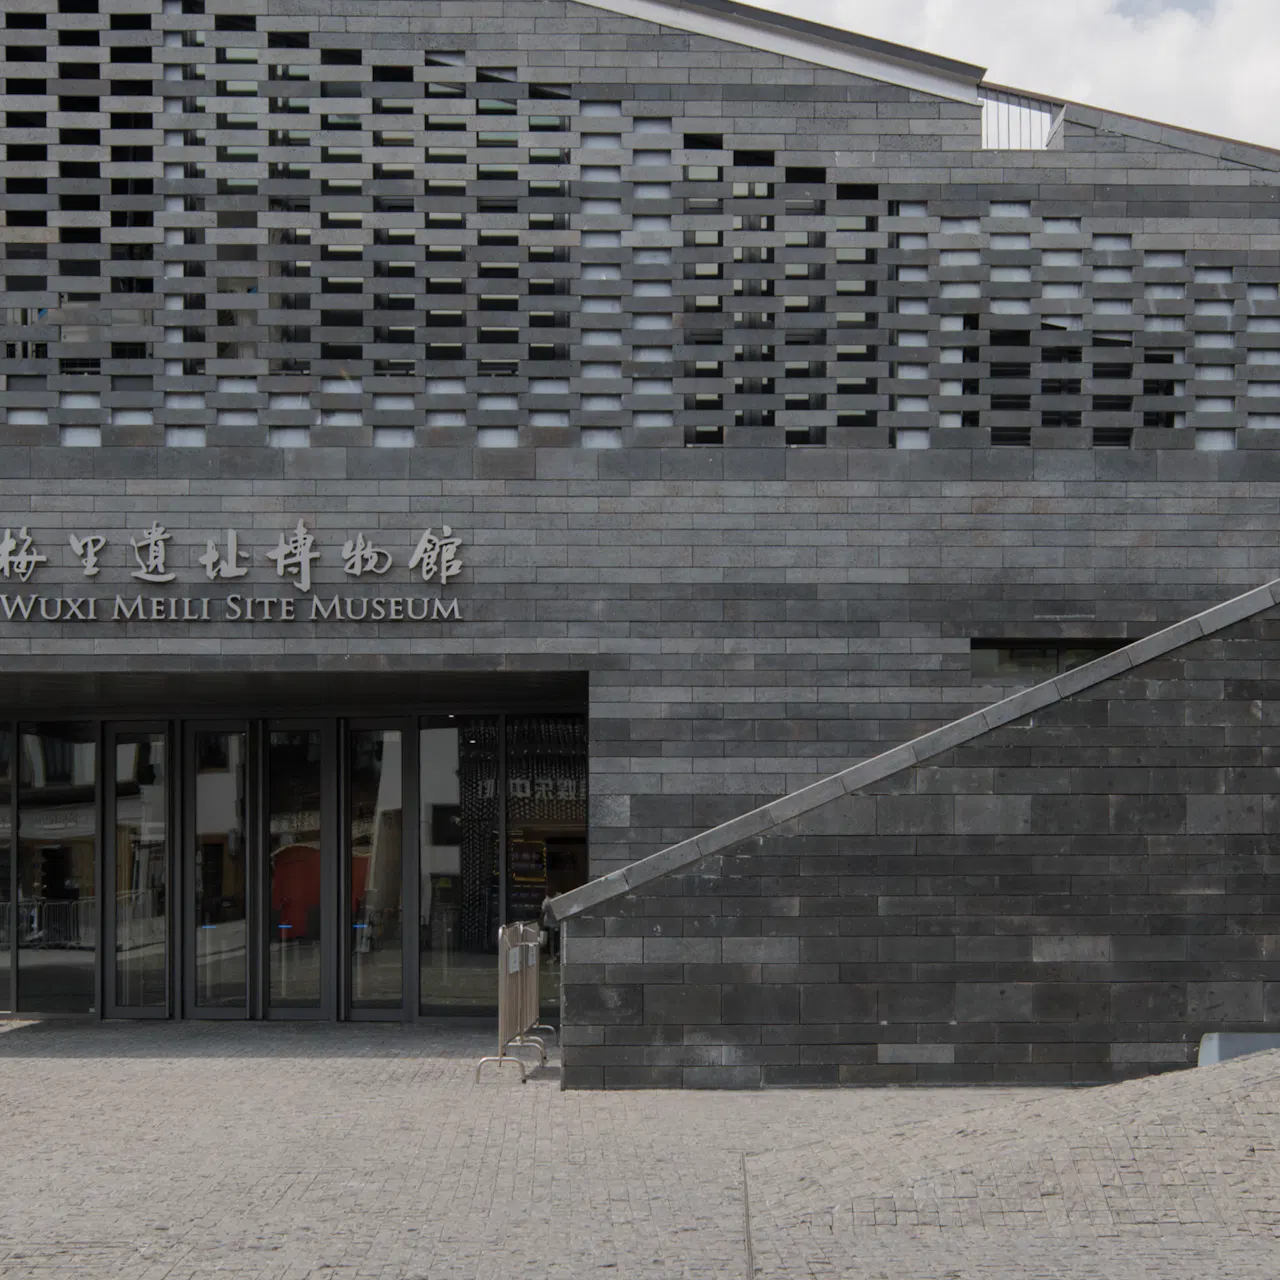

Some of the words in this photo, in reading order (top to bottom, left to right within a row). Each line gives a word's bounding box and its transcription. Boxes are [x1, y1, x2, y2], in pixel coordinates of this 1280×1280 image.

[111, 593, 211, 620] MEILI
[225, 593, 296, 620] SITE
[308, 593, 464, 620] MUSEUM
